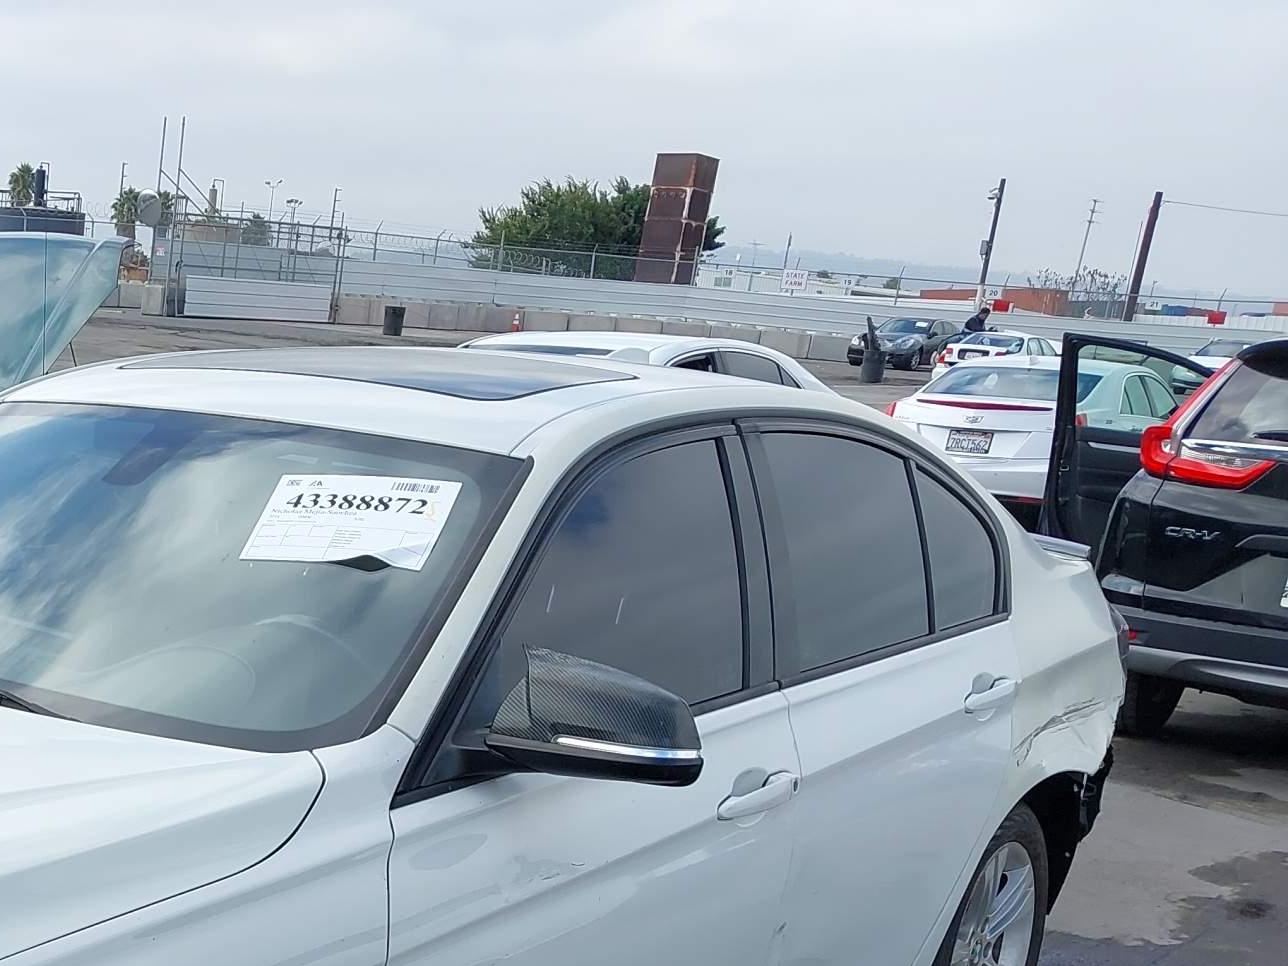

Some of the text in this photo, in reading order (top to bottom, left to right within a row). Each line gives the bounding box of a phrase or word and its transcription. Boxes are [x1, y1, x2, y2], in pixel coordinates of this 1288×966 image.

[785, 271, 805, 279] STATE
[784, 279, 803, 287] FARM
[989, 289, 999, 297] 20
[285, 492, 428, 515] 43388872
[1165, 526, 1221, 540] CR-V
